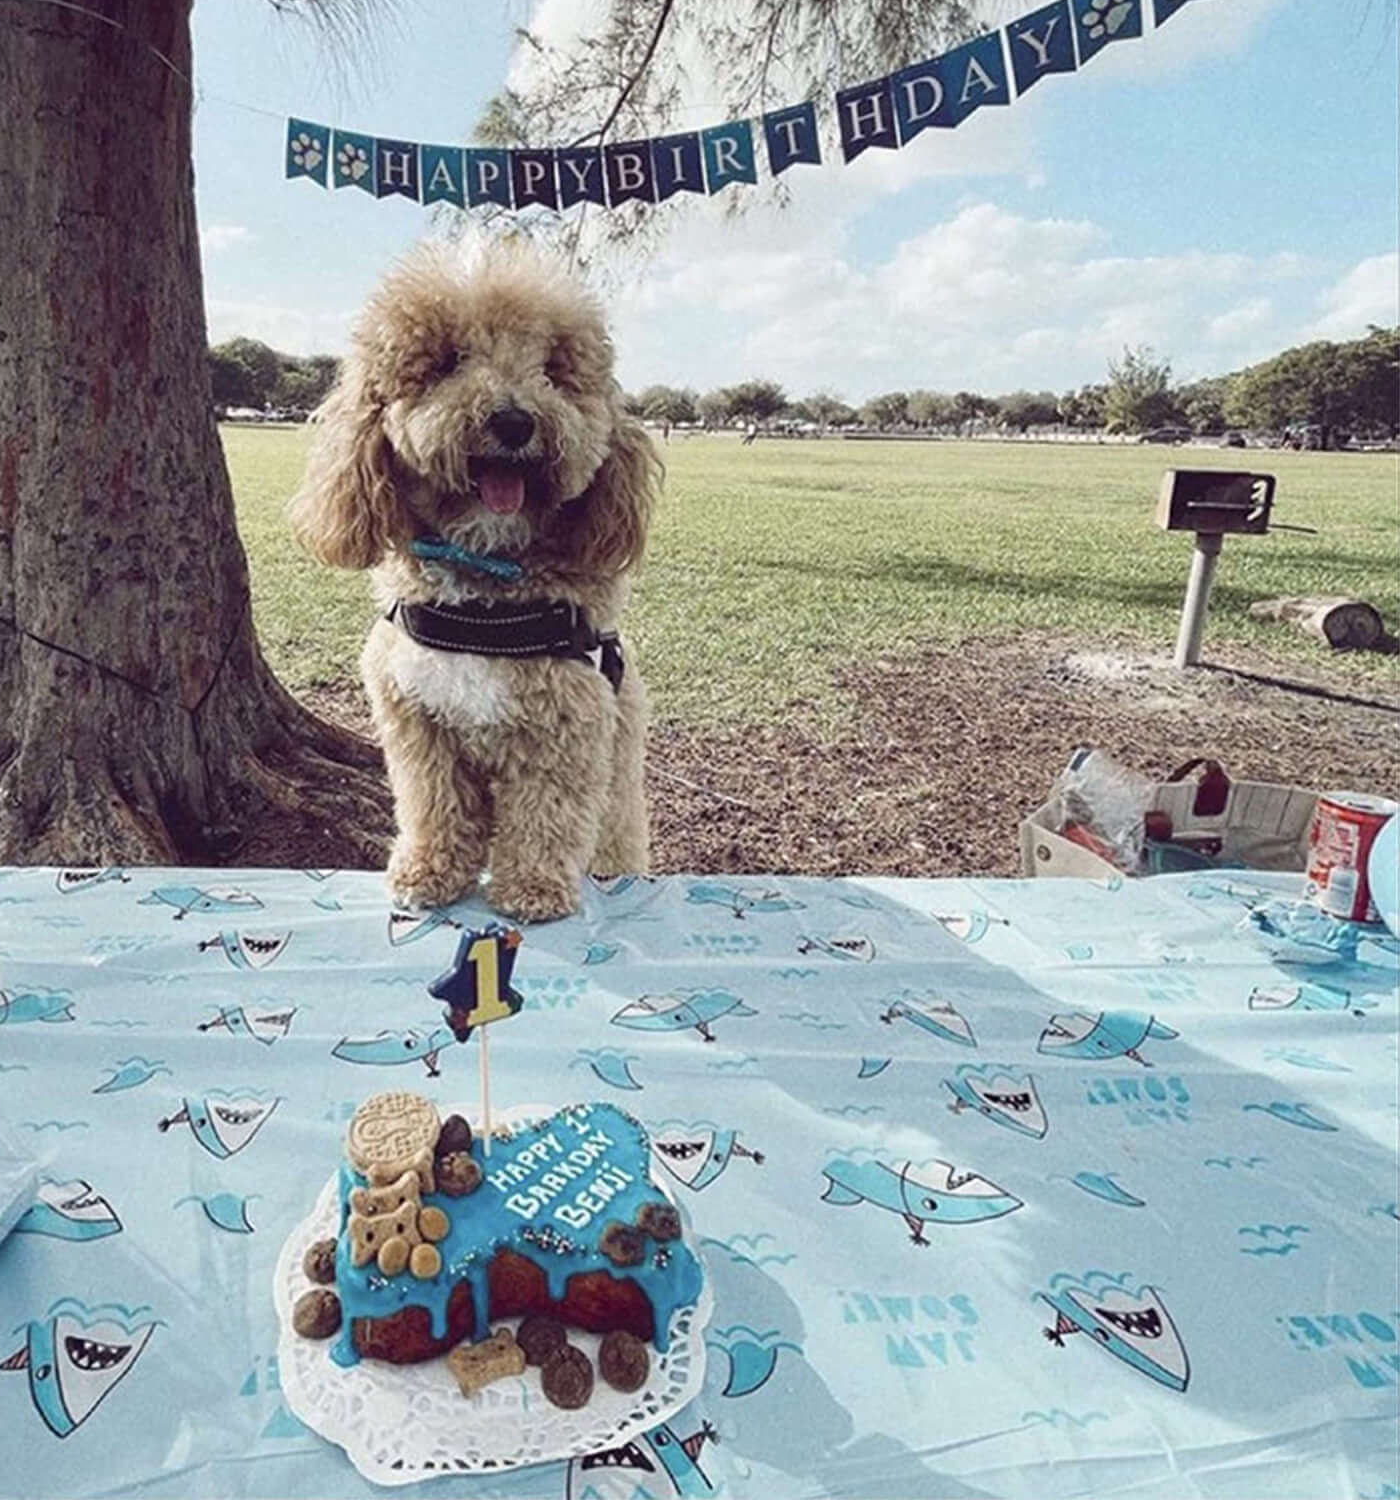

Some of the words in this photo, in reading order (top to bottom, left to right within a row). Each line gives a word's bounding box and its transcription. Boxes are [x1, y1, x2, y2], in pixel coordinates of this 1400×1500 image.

[466, 937, 513, 1027] 1
[487, 1131, 564, 1193] HAPPY
[505, 1129, 615, 1220] BARKDAY
